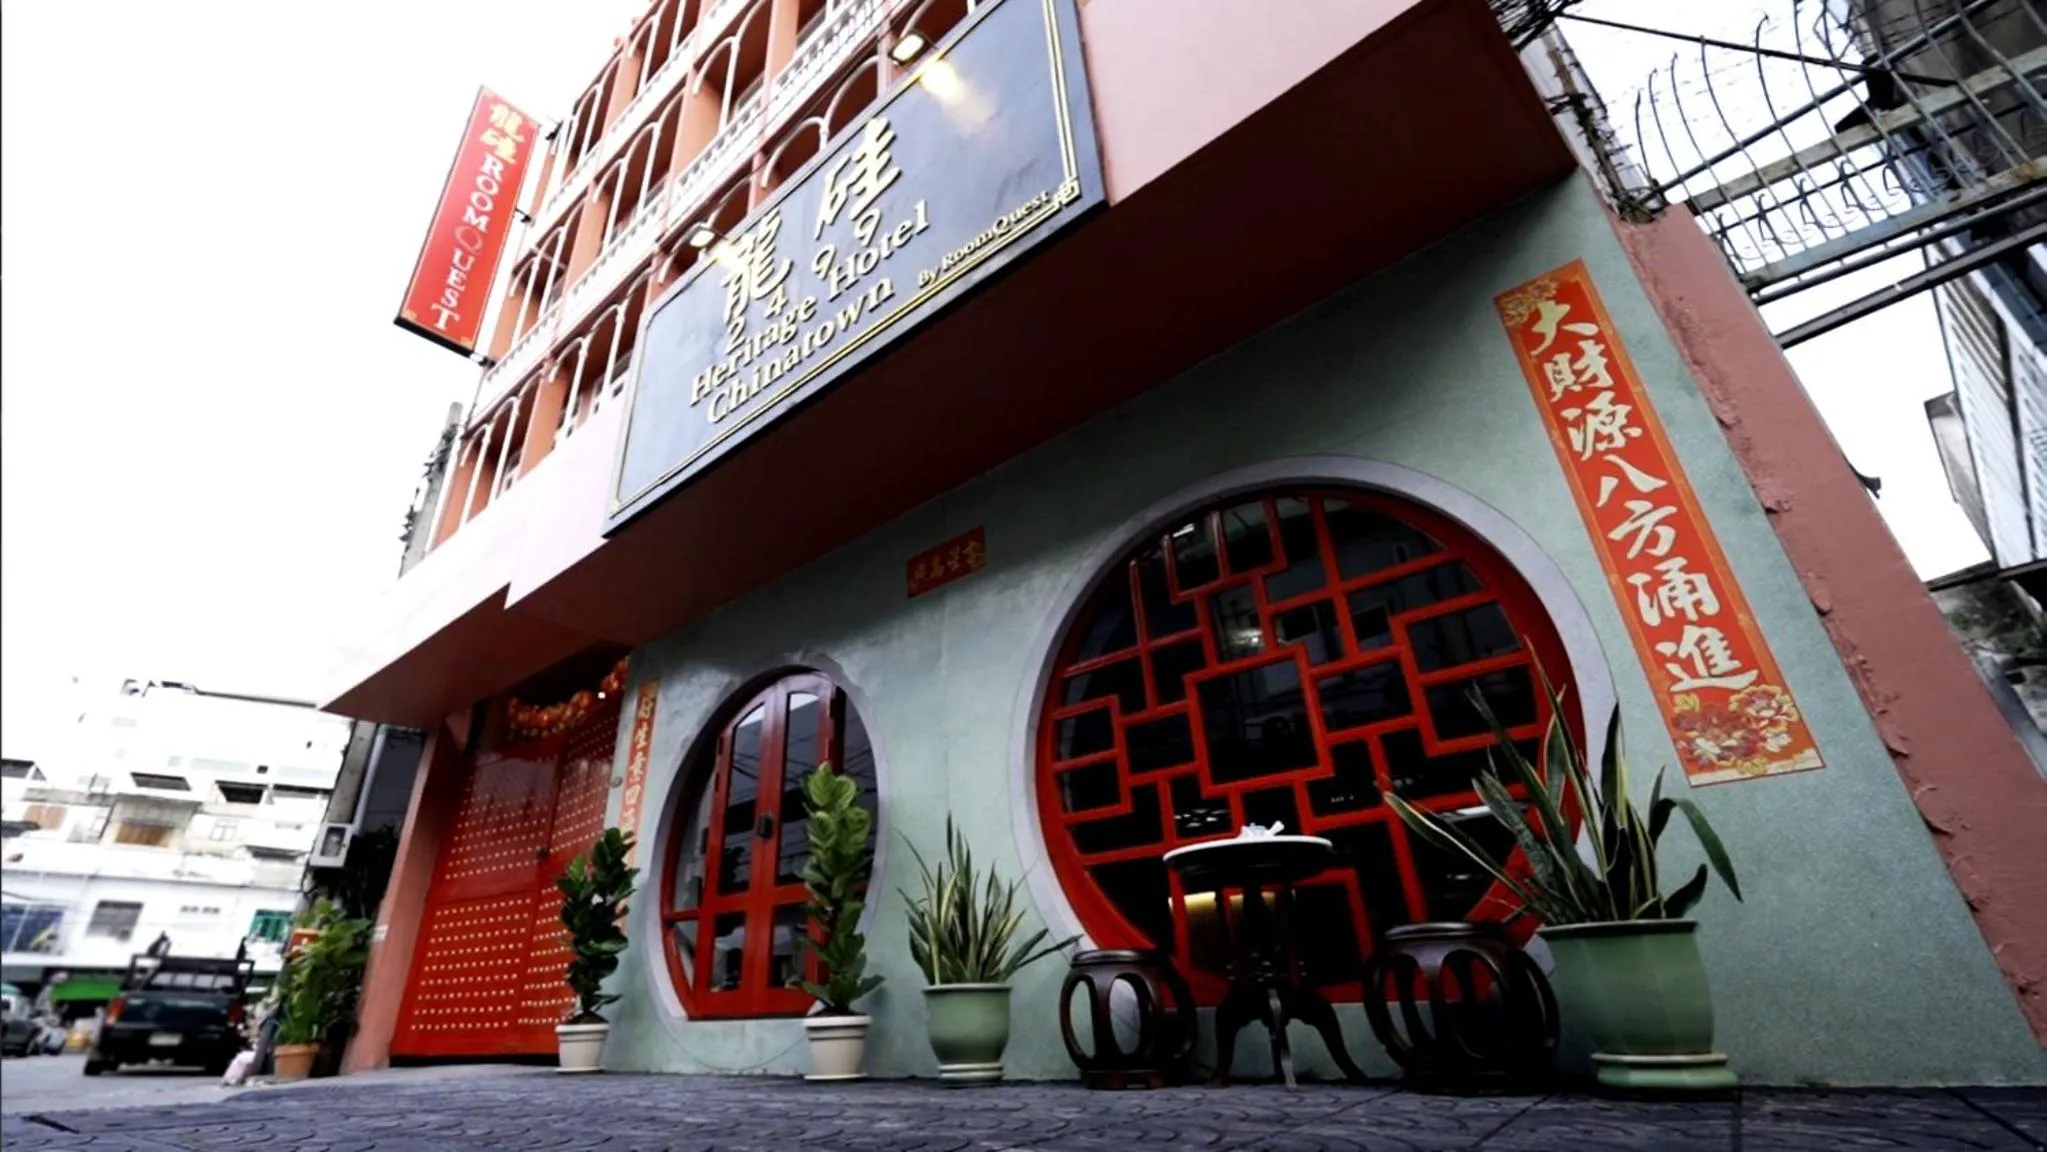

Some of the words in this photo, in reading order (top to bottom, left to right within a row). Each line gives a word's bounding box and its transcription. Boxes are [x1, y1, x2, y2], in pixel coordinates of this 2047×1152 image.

[431, 153, 505, 330] ROOMQUEST
[690, 295, 818, 406] Heritage
[829, 199, 930, 302] Hotel
[918, 267, 940, 288] By
[941, 190, 1050, 271] RoomQuest
[708, 278, 895, 424] Chinatown
